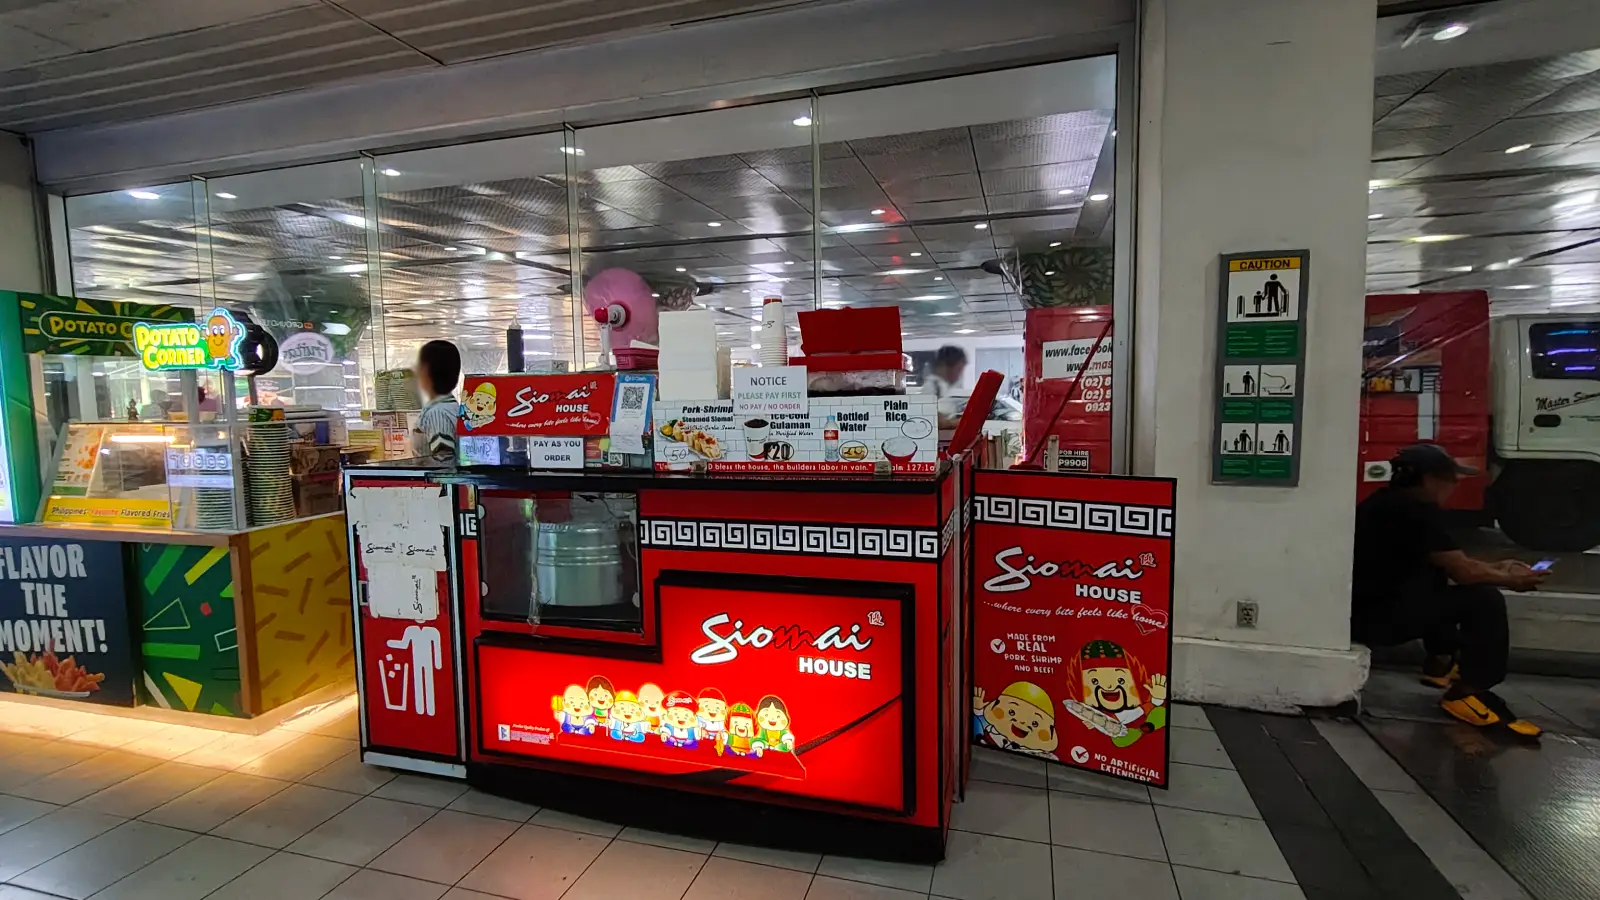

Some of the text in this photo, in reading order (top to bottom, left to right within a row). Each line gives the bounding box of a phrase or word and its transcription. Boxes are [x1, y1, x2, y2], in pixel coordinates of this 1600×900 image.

[1240, 260, 1290, 270] CAUTION
[49, 316, 117, 335] POTATO
[136, 326, 200, 350] POTATO
[1045, 343, 1112, 358] www.faceook
[143, 345, 206, 369] CORNER
[751, 377, 787, 386] NOTICE
[1080, 376, 1103, 389] (02)
[781, 391, 801, 399] FIRST
[1081, 389, 1104, 402] (02)
[507, 386, 591, 417] Siomai
[884, 400, 908, 411] Plain
[1085, 402, 1111, 412] 0923
[556, 404, 589, 413] HOUSE
[682, 405, 733, 414] Pork-Shrimp
[837, 412, 869, 421] Bottled
[886, 411, 907, 422] Rice
[770, 421, 811, 429] Gulaman
[839, 422, 867, 431] Water
[818, 463, 838, 471] labor
[1058, 459, 1087, 467] P9908
[121, 508, 151, 517] Flavored
[153, 510, 170, 518] Fries
[0, 544, 87, 579] FLAVOR
[984, 546, 1143, 592] Siomai
[1075, 584, 1142, 604] HOUSE
[21, 583, 68, 617] THE
[1025, 607, 1051, 617] every
[1055, 606, 1074, 616] bite
[1077, 607, 1102, 618] feels
[1107, 608, 1128, 619] like
[0, 620, 108, 653] MOMENT!
[690, 613, 872, 664] Siomai
[1007, 633, 1056, 642] MADE FROM
[1017, 641, 1047, 653] REAL
[799, 657, 871, 680] HOUSE
[1014, 664, 1031, 672] AND
[1094, 753, 1107, 762] NO
